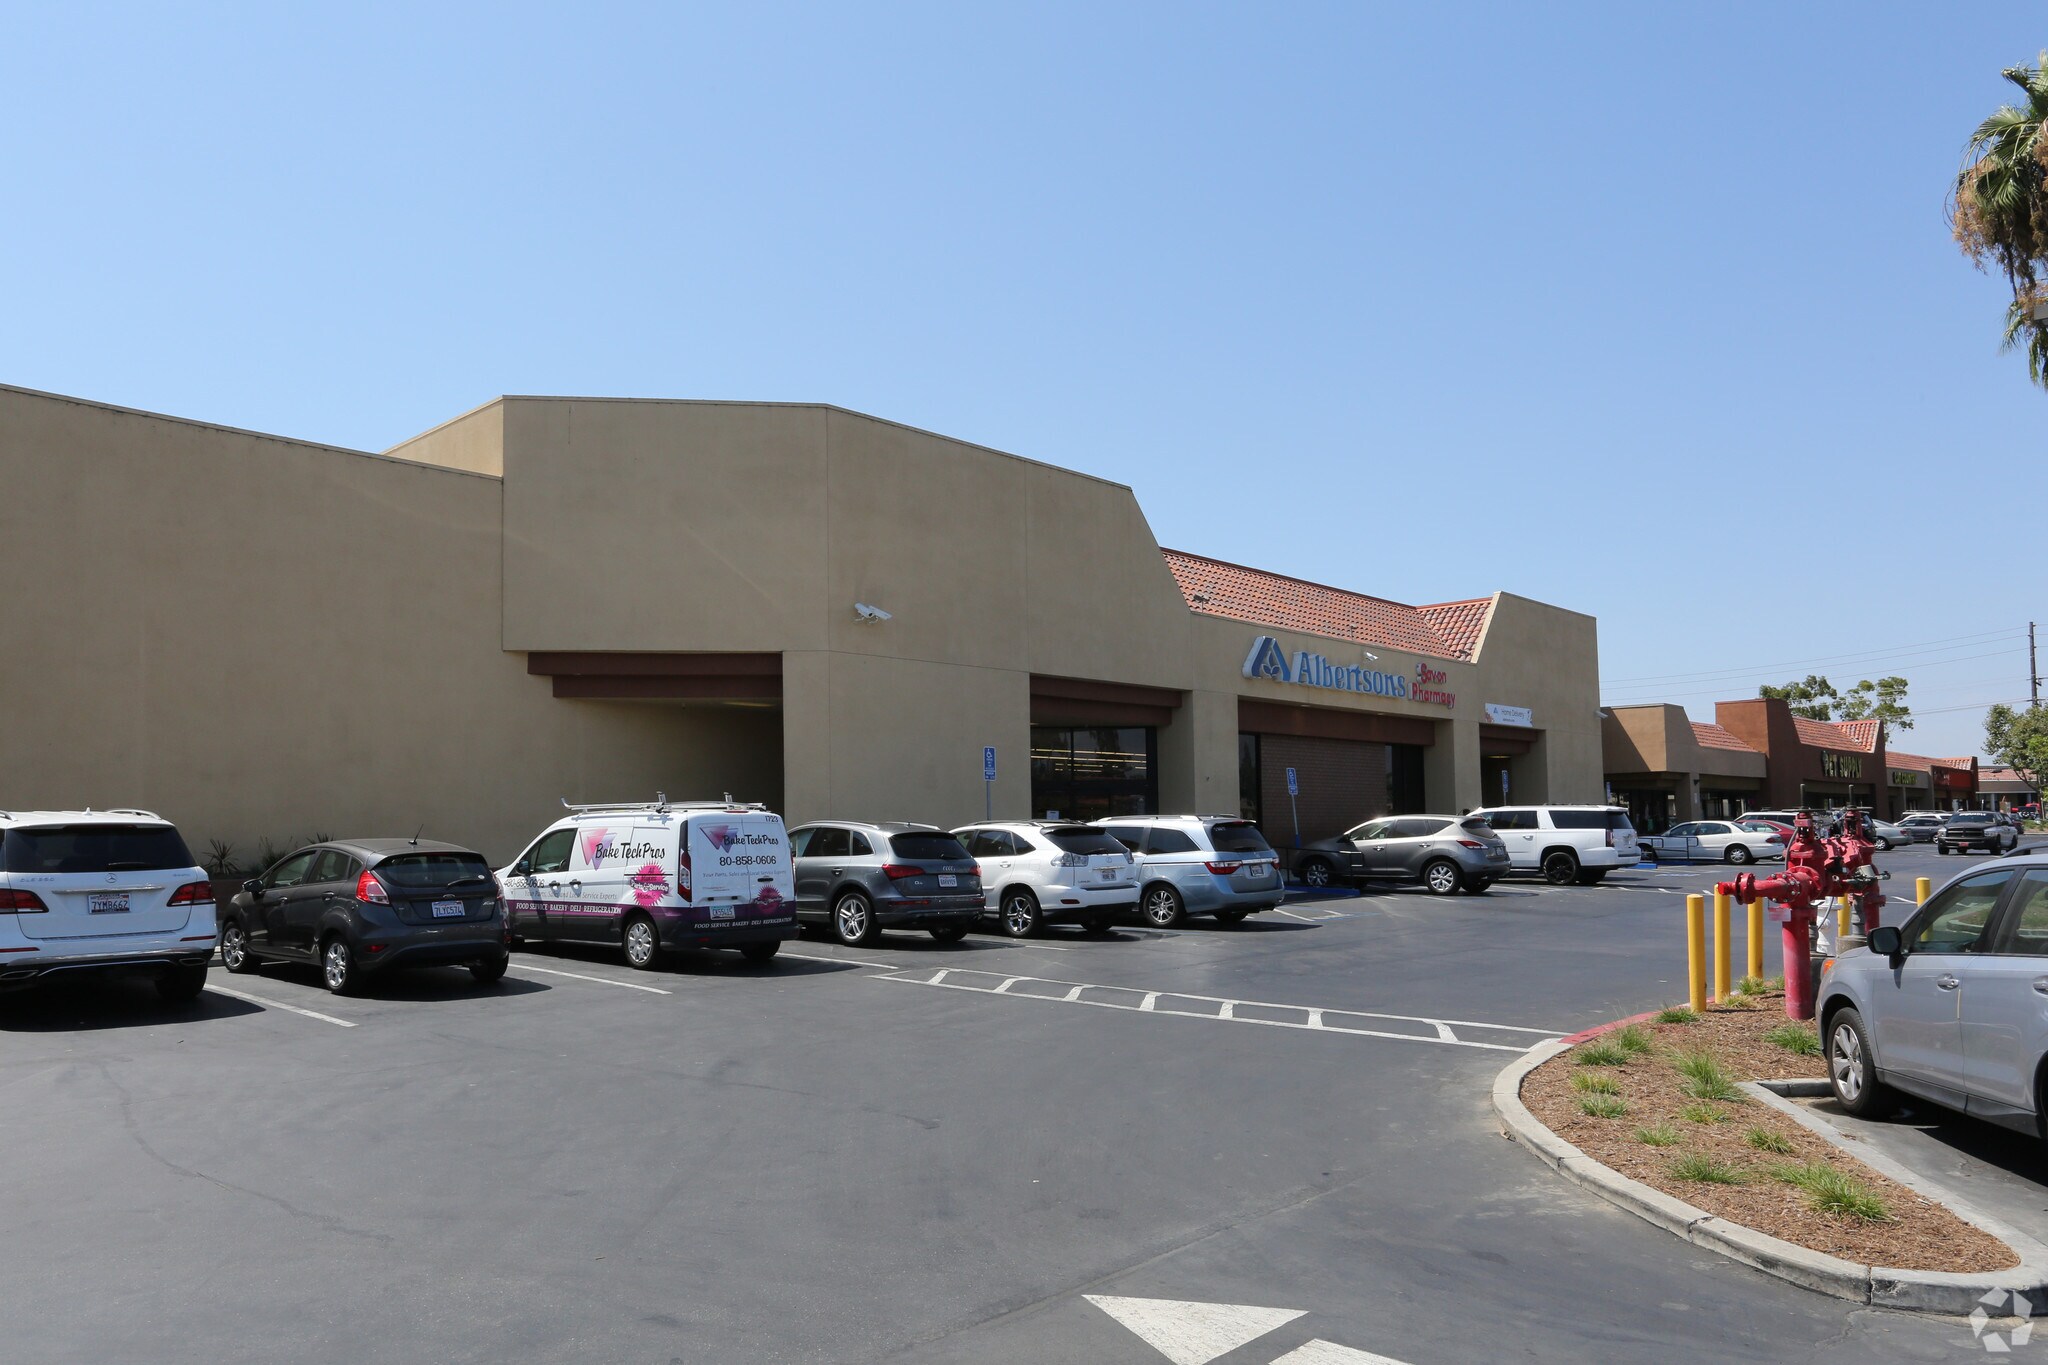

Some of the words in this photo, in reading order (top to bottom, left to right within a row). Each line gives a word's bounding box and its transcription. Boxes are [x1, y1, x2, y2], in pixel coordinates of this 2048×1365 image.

[1294, 651, 1406, 698] Albertsons
[1409, 682, 1456, 709] Pharmacy
[1822, 753, 1838, 777] PET
[1839, 755, 1862, 779] SUPPLY
[550, 904, 568, 912] BAKERY
[583, 905, 622, 914] REFRIGERATION
